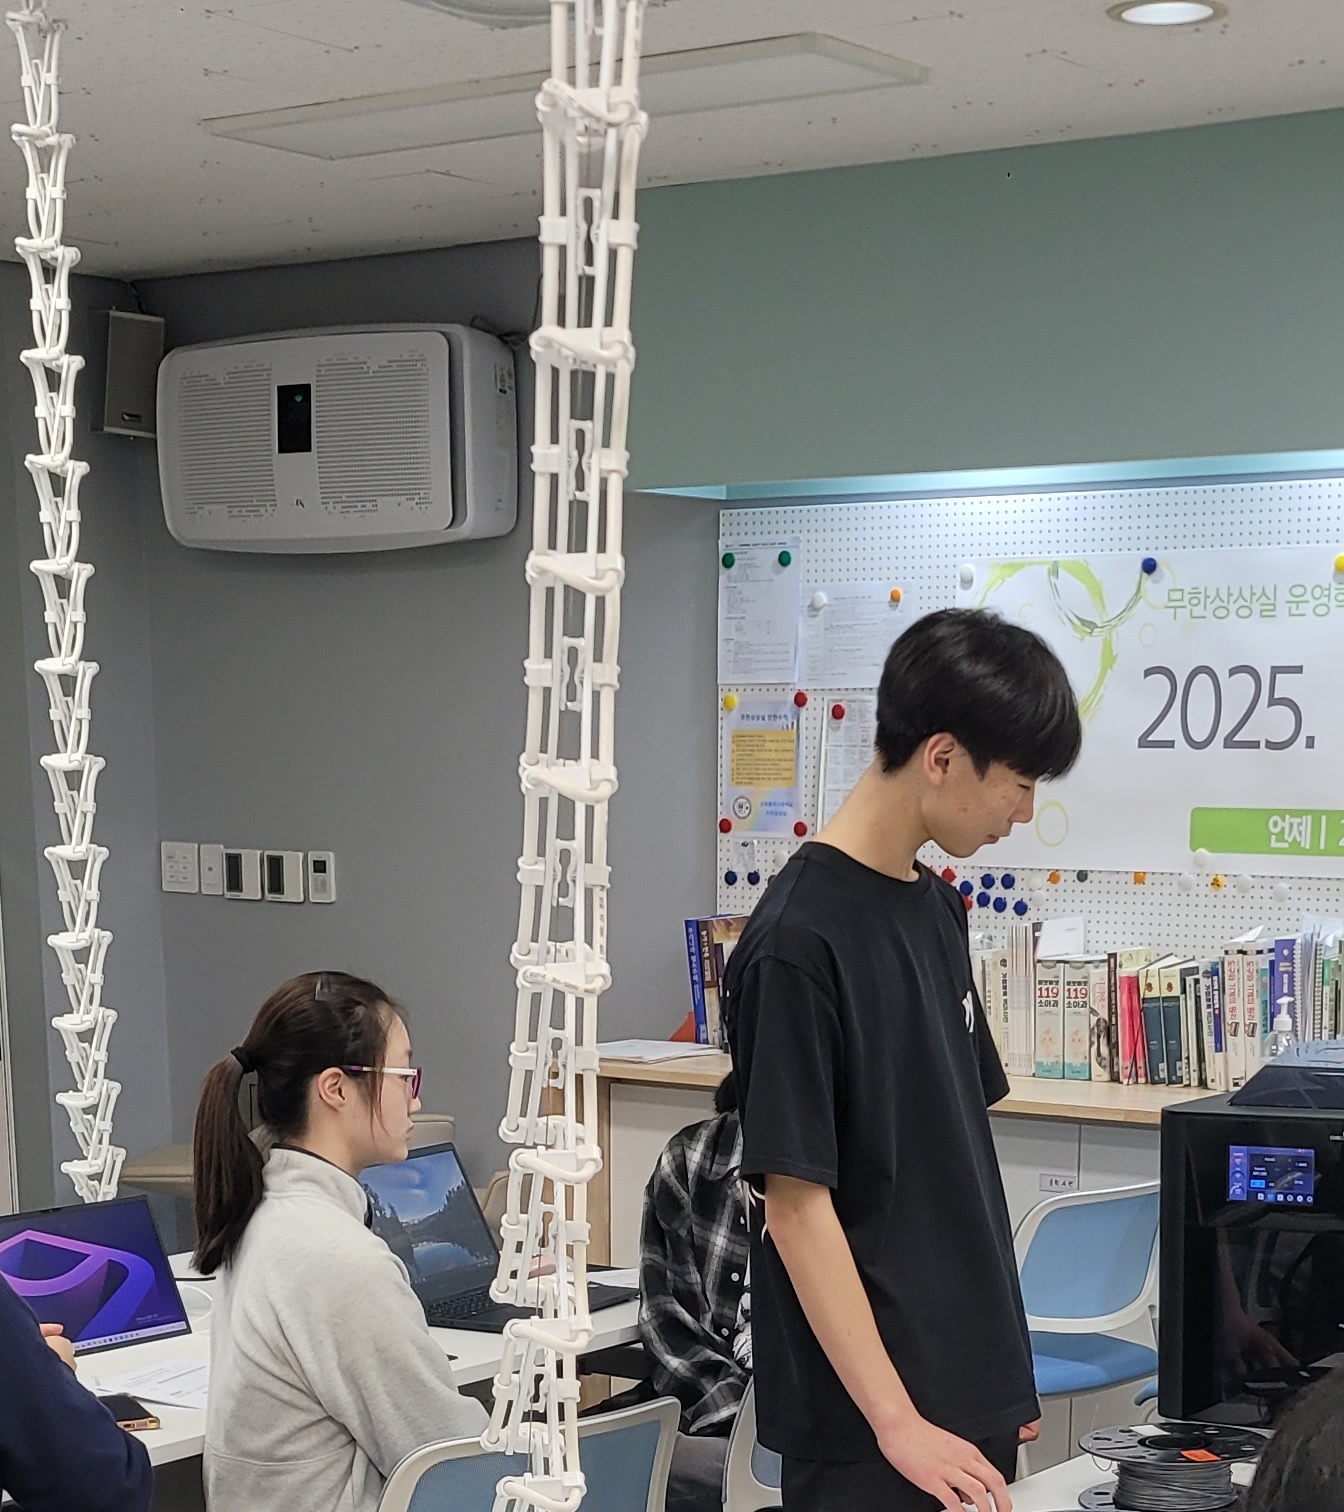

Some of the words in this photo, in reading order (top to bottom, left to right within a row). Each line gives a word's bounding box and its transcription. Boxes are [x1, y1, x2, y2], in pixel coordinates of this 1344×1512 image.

[1165, 584, 1277, 620] 무한상상실
[1137, 665, 1315, 751] 2025.
[1268, 814, 1312, 849] 언제
[1228, 960, 1236, 981] 도구와
[1246, 960, 1254, 981] 도구와
[1037, 986, 1060, 999] 119
[1066, 987, 1088, 1000] 119
[1229, 983, 1237, 1004] 기계의
[1247, 983, 1255, 1004] 기계의
[1038, 1000, 1059, 1008] 소아과
[1066, 1001, 1088, 1009] 소아과
